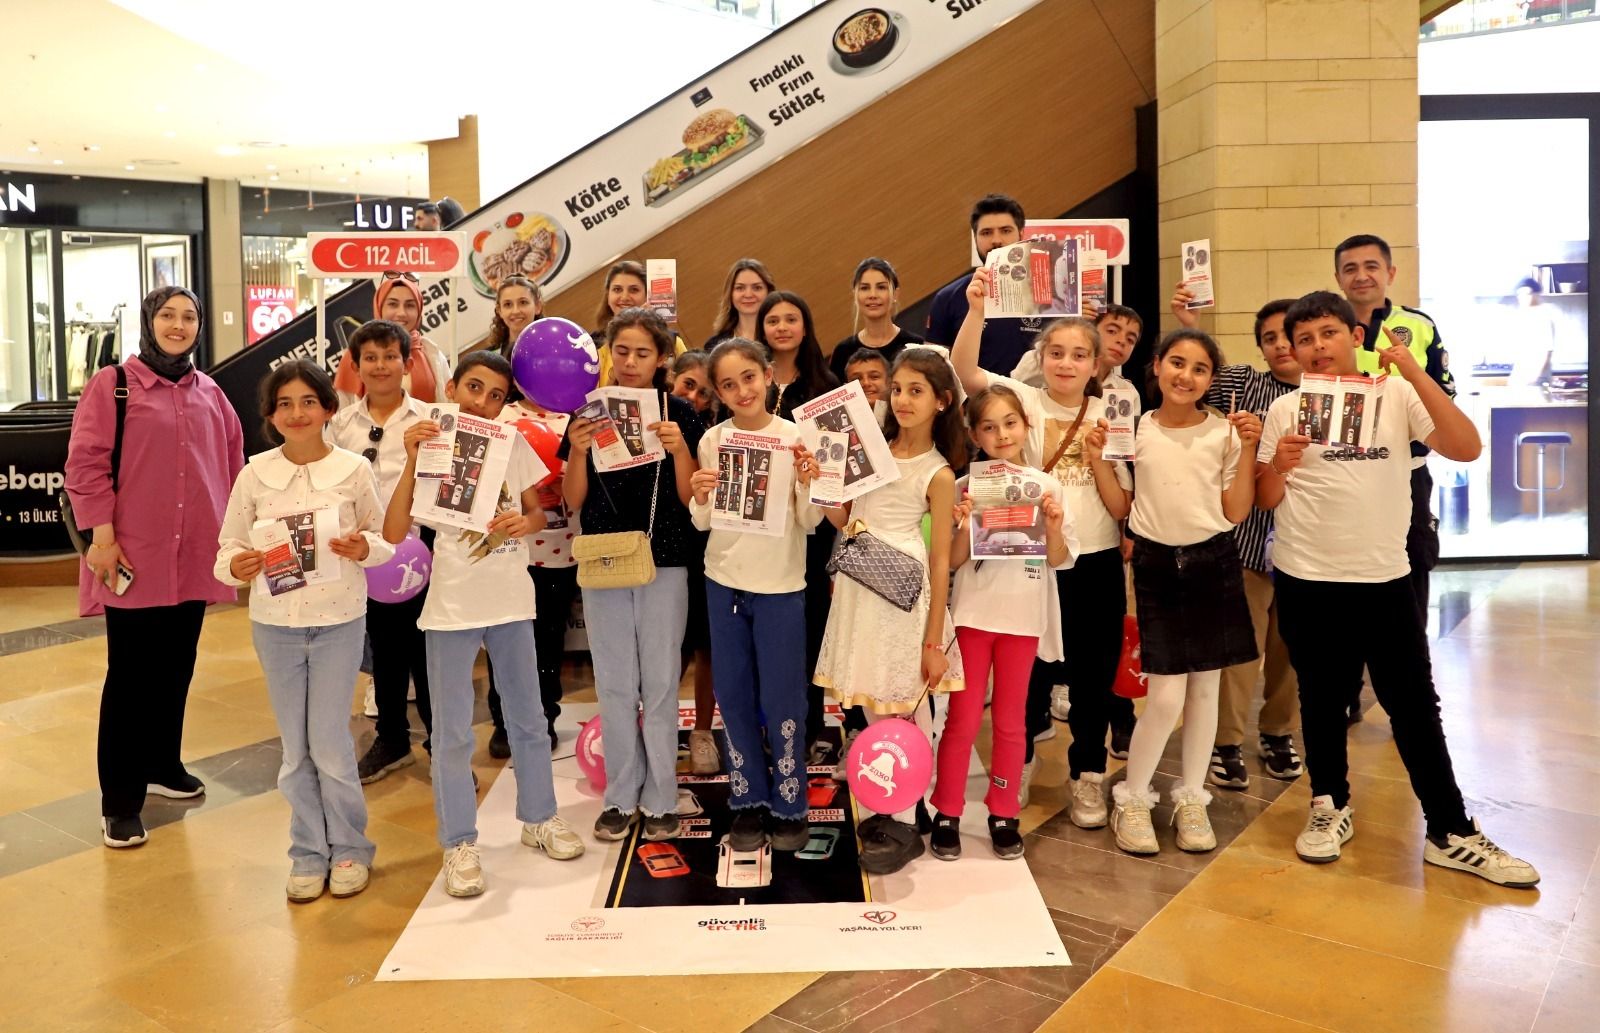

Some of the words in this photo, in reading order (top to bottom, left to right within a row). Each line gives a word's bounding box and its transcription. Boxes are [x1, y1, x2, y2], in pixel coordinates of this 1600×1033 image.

[749, 54, 805, 93] Fındıklı
[778, 71, 815, 97] Fırın
[768, 87, 826, 127] Sütlaç
[564, 177, 622, 218] Köfte
[580, 195, 631, 231] Burger
[364, 246, 390, 266] 112
[395, 242, 436, 266] ACİL
[252, 306, 293, 334] 60
[799, 405, 827, 421] YAŞAMA
[826, 400, 840, 409] YOL
[840, 392, 857, 403] VER!
[474, 427, 489, 436] YOL
[490, 431, 508, 440] VER!
[726, 437, 755, 447] YAŞAMA
[756, 441, 770, 449] YOL
[19, 511, 30, 523] 13
[33, 508, 58, 523] ÜLKE
[697, 918, 759, 928] güvenli
